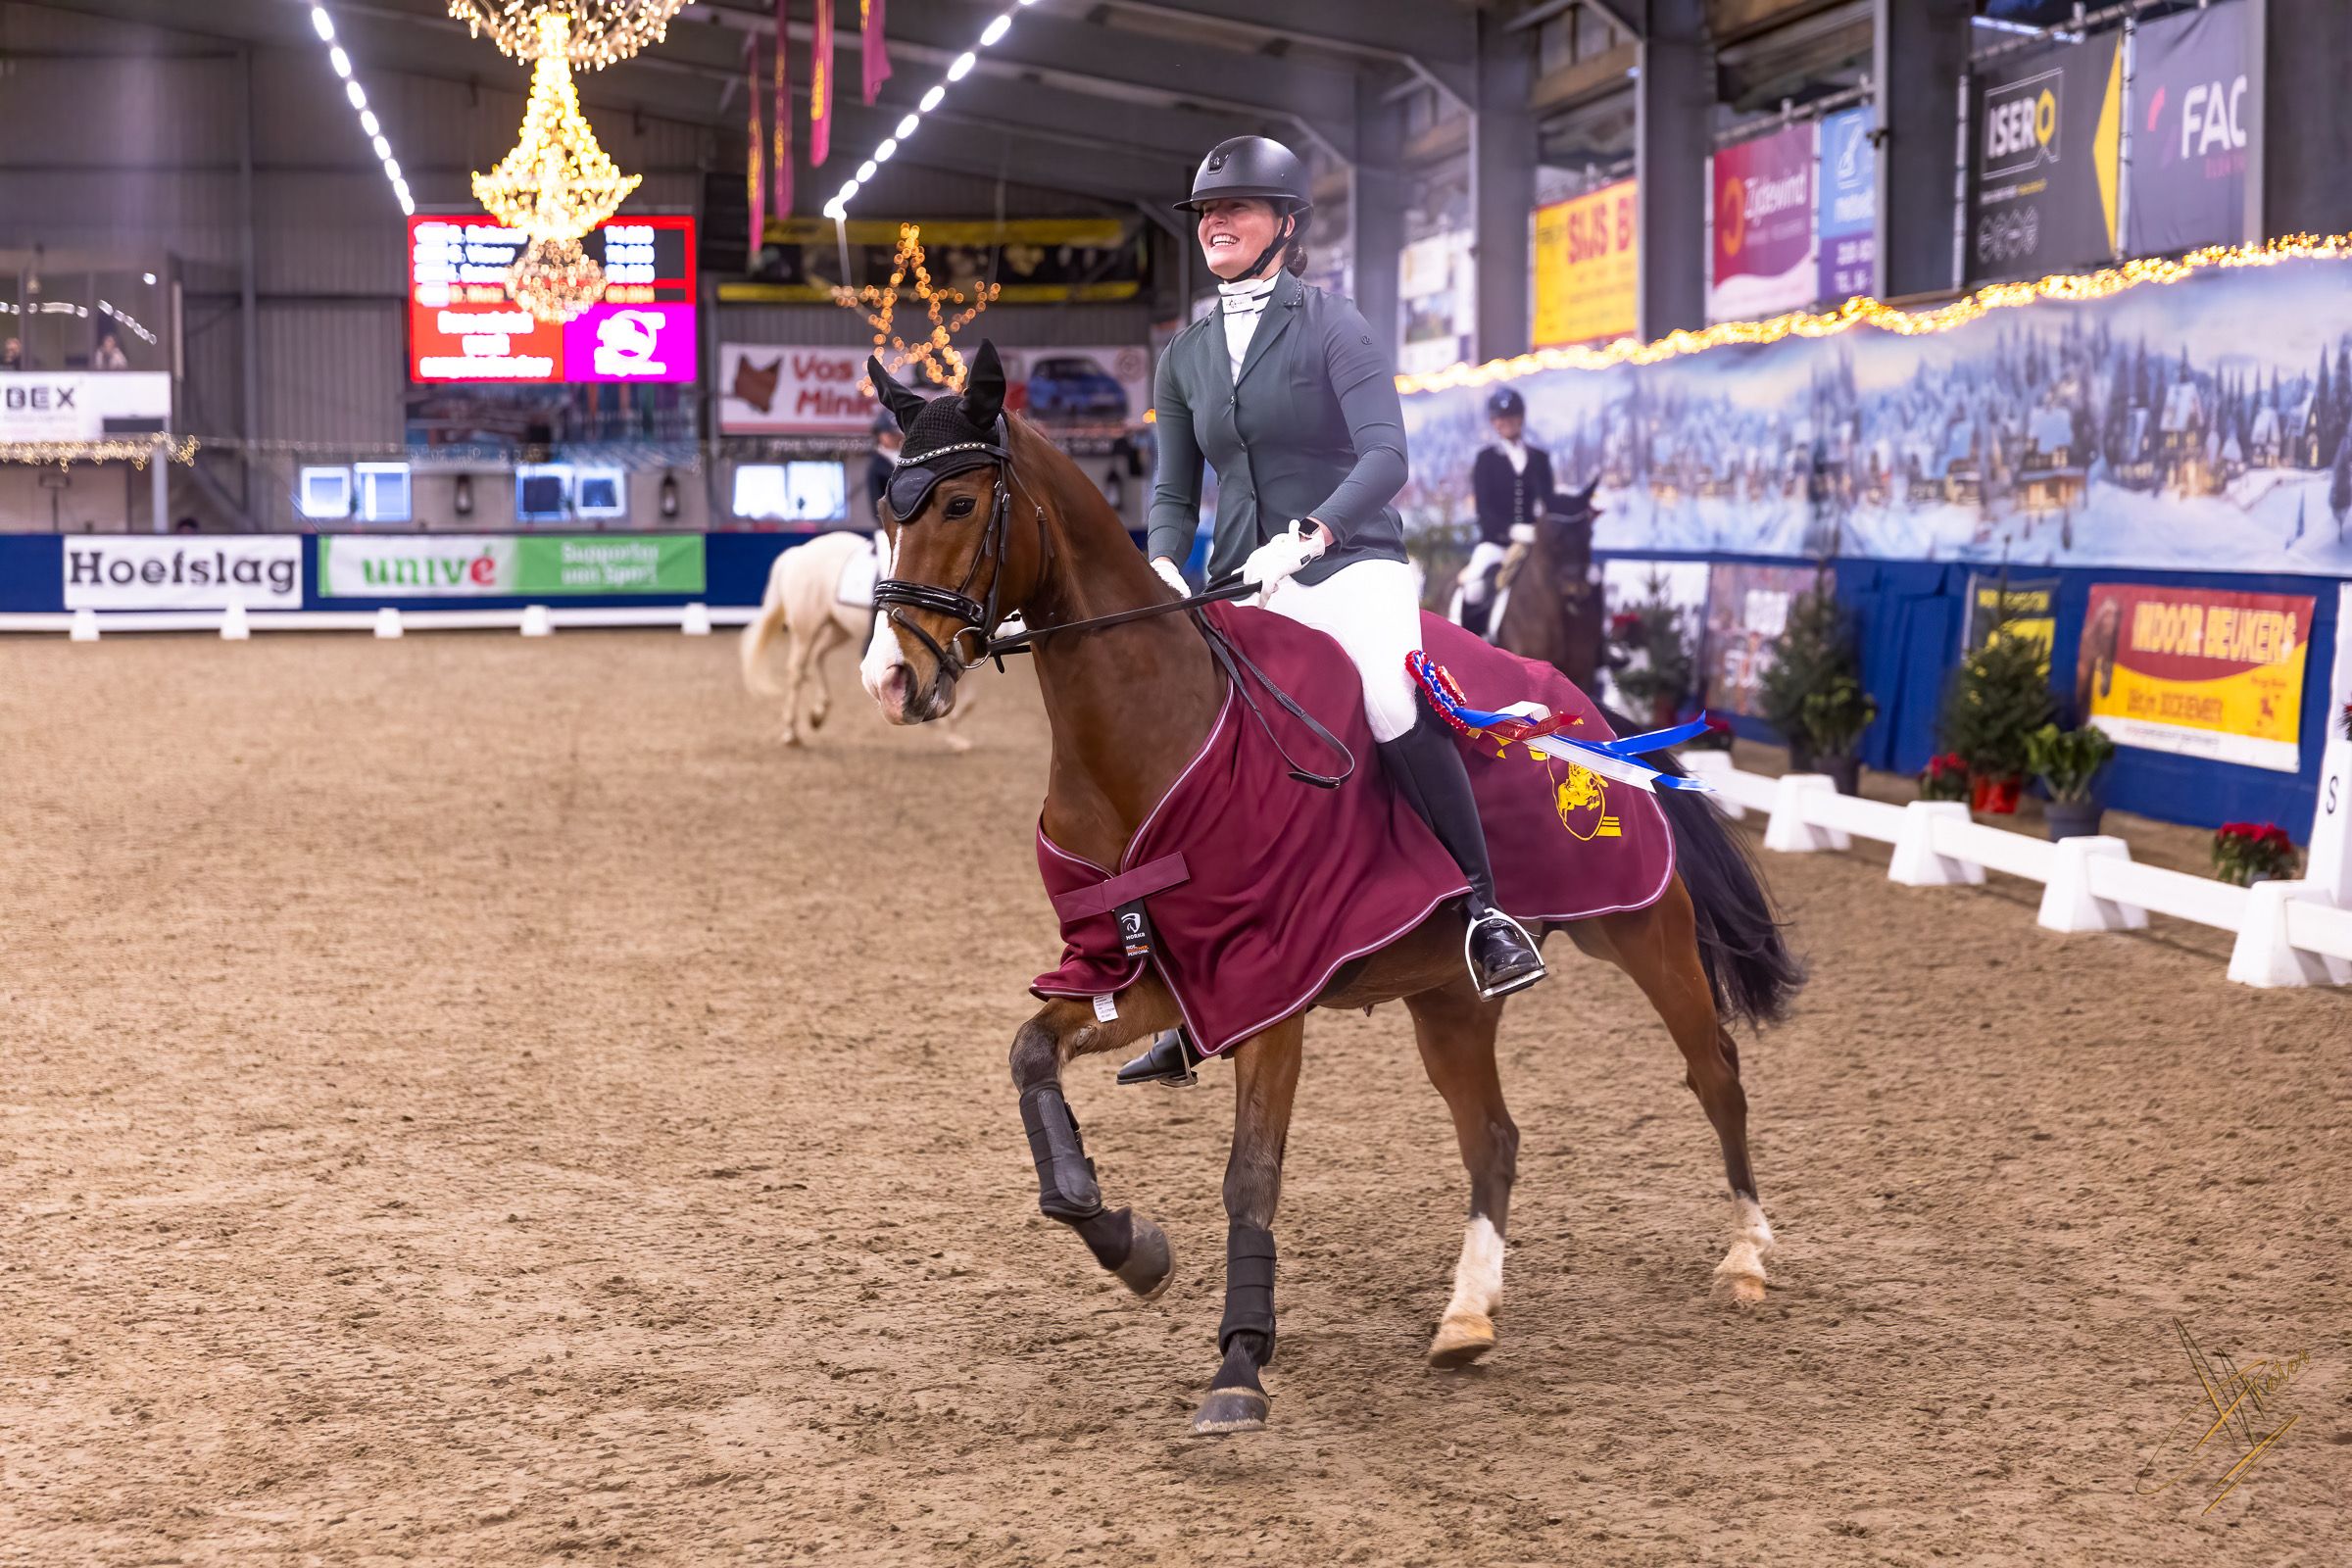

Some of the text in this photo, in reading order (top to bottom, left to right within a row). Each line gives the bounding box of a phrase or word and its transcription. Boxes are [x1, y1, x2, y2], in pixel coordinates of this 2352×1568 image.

[1987, 88, 2056, 159] ISERO
[792, 354, 855, 382] Vos
[0, 386, 75, 409] BEX
[70, 551, 296, 595] Hoefslag
[362, 545, 497, 587] univé
[2132, 601, 2297, 664] INDOOR BEUKERS
[2326, 775, 2339, 815] S
